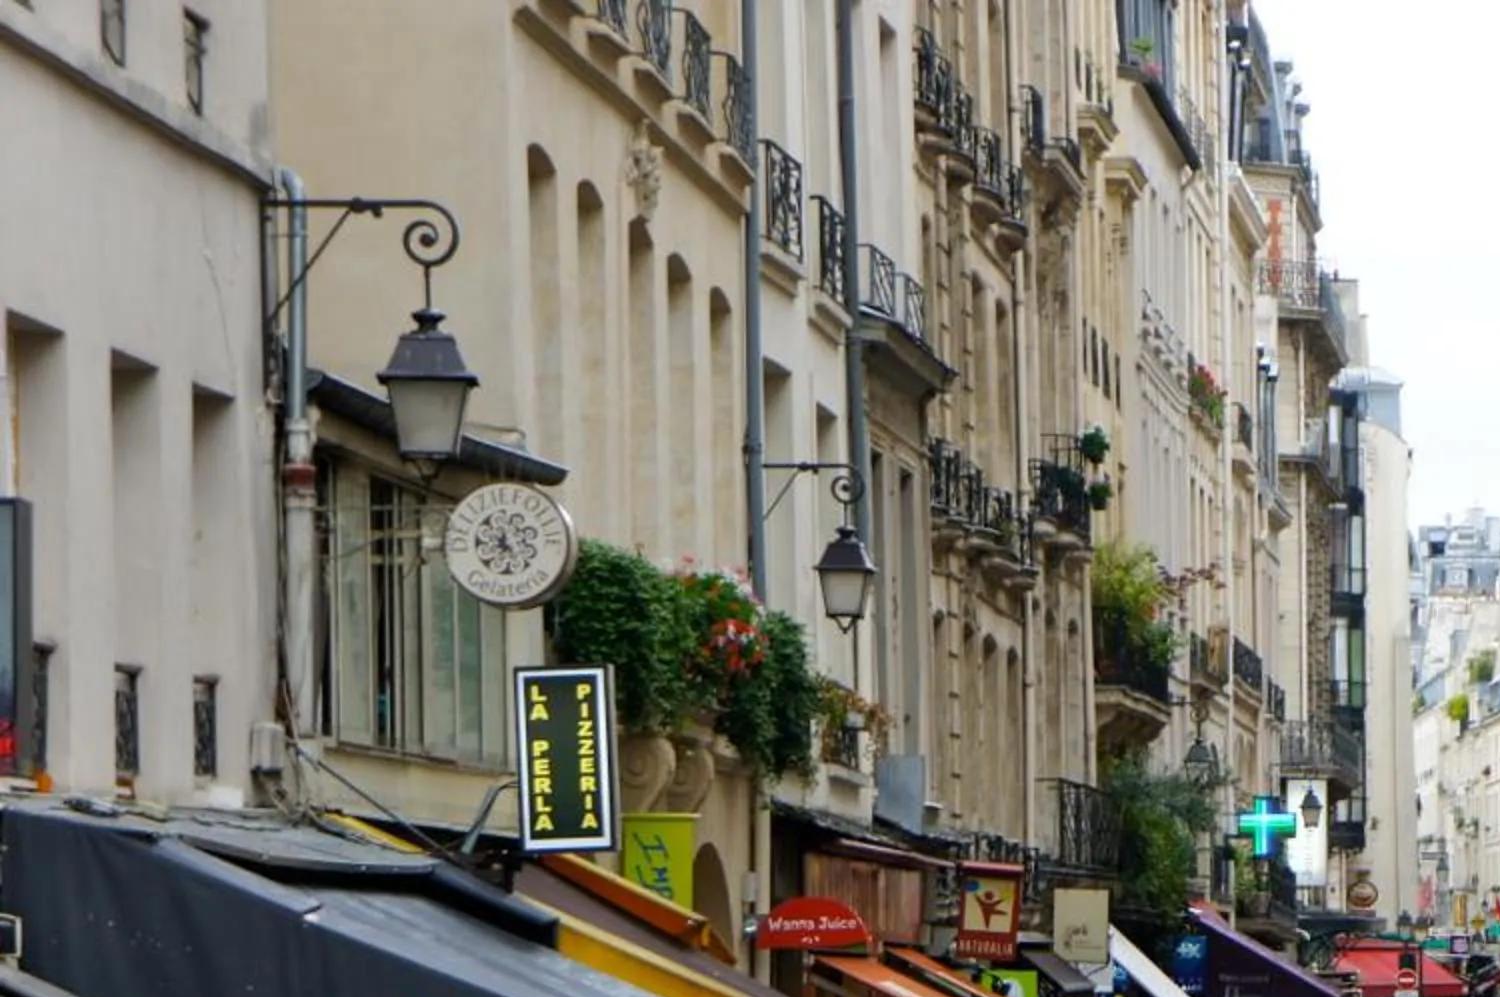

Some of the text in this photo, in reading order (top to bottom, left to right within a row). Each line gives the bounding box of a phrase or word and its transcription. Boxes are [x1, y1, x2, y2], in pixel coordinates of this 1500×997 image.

[469, 569, 548, 597] Gelateria
[530, 684, 554, 831] LA PERLA
[576, 683, 598, 829] PIZZERIA
[818, 915, 858, 930] Juice
